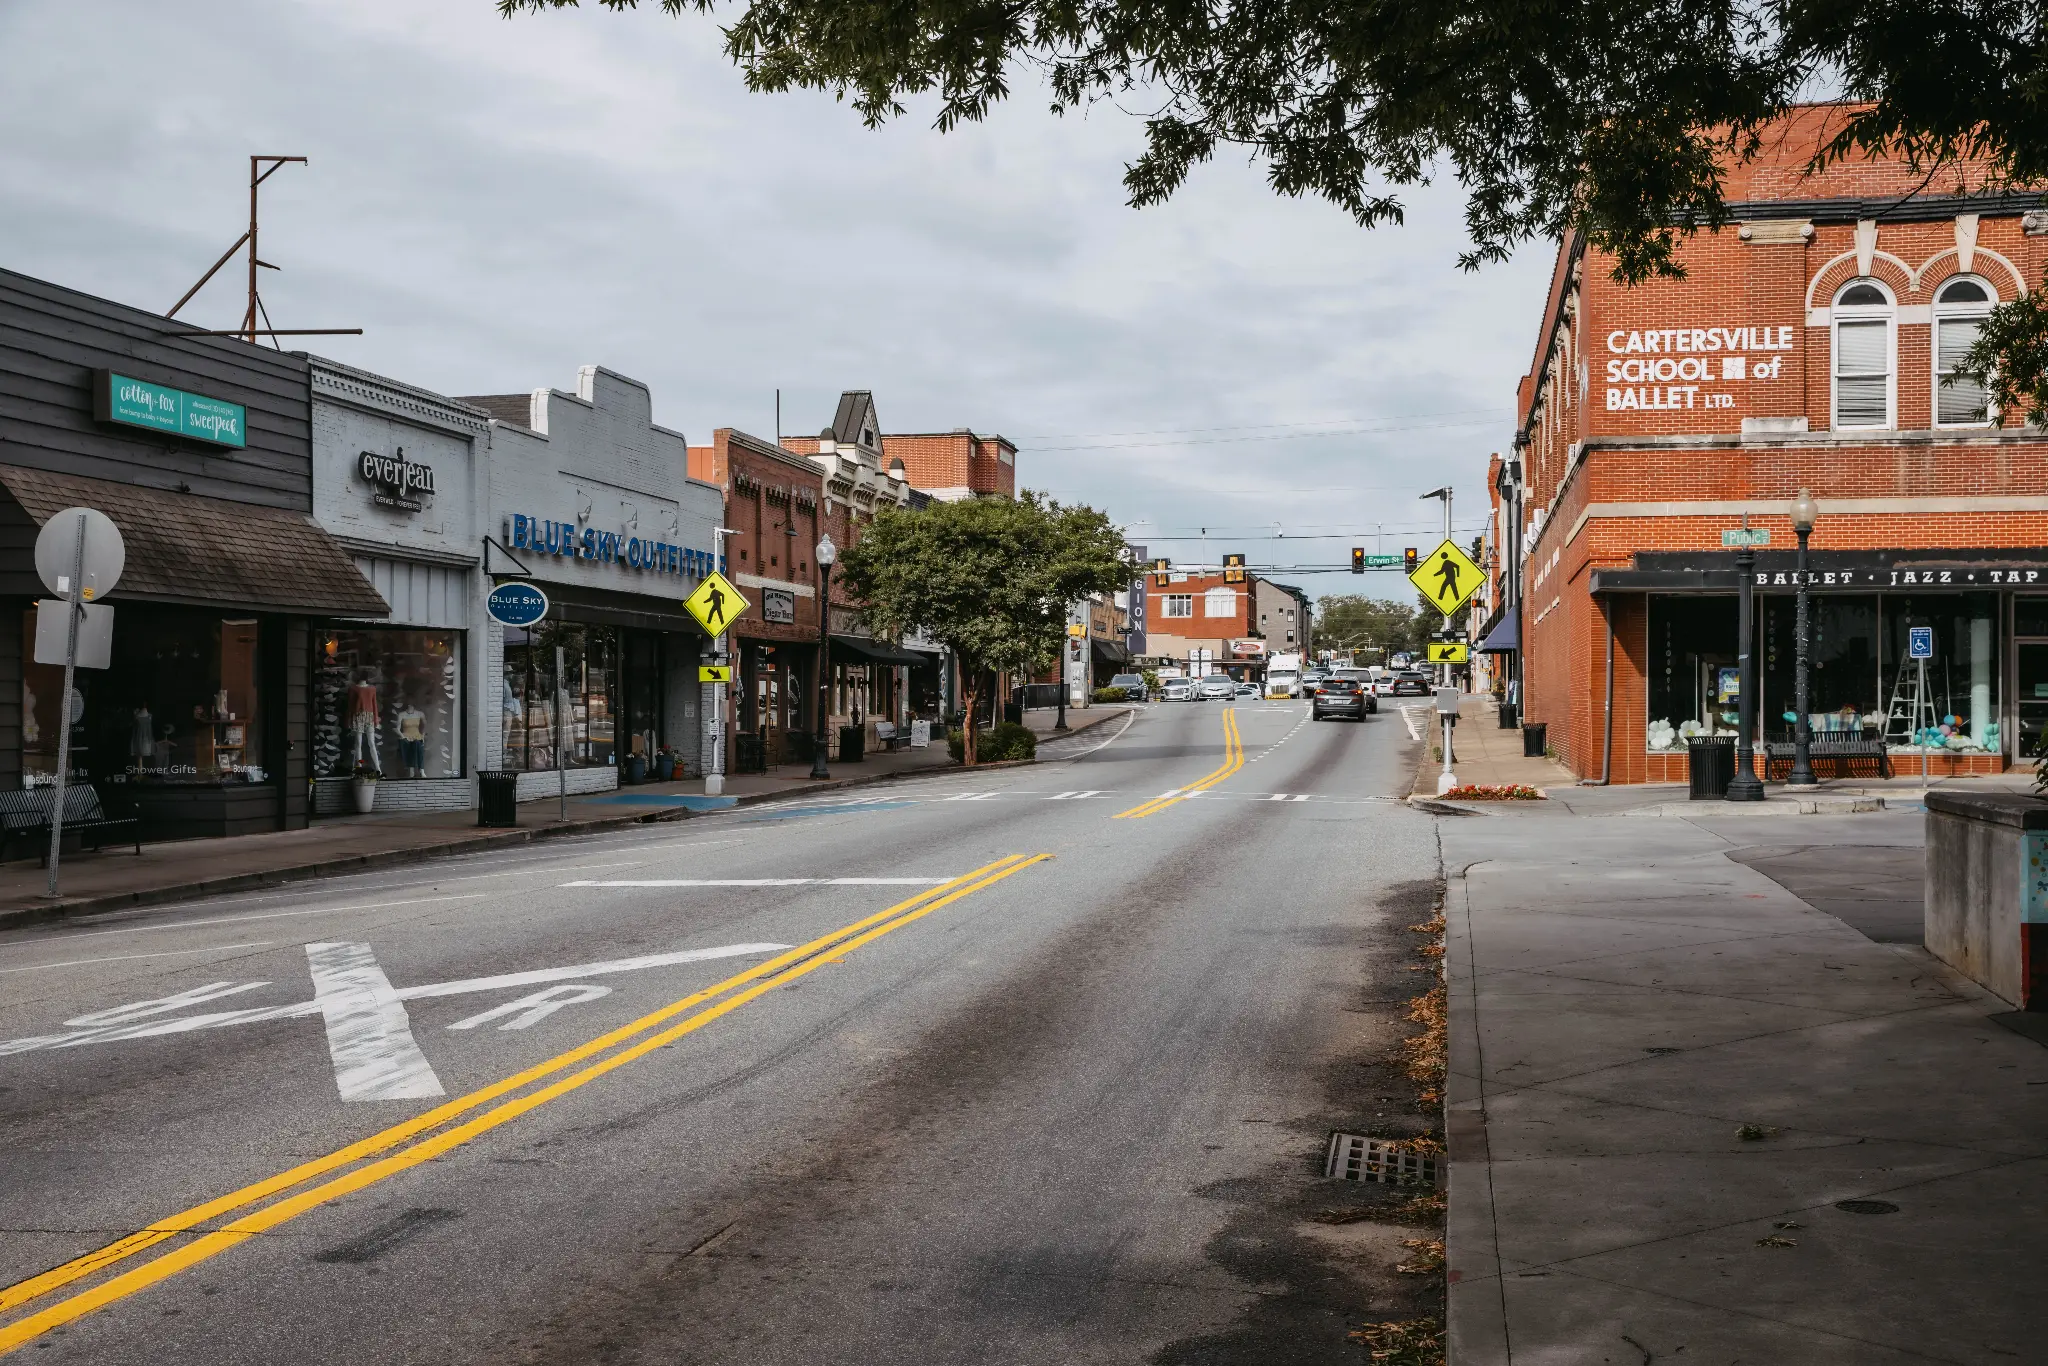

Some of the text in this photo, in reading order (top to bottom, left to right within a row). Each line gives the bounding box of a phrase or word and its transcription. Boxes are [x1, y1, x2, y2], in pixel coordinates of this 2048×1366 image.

[1606, 326, 1793, 354] CARTERSVILLE
[1606, 356, 1782, 383] SCHOOL of
[120, 384, 153, 412] cotton
[159, 393, 175, 413] fox
[1606, 386, 1736, 411] BALLET LTD.
[363, 454, 436, 497] everjean
[509, 513, 575, 558] BLUE
[580, 526, 623, 566] SKY
[1729, 531, 1761, 544] Public
[1368, 556, 1400, 565] Erwin St
[1134, 551, 1143, 631] LGION
[1890, 571, 1953, 586] JAZZ
[1990, 570, 2040, 584] TAP
[765, 607, 793, 620] Cigar Bar
[126, 763, 197, 774] Shower Gifts
